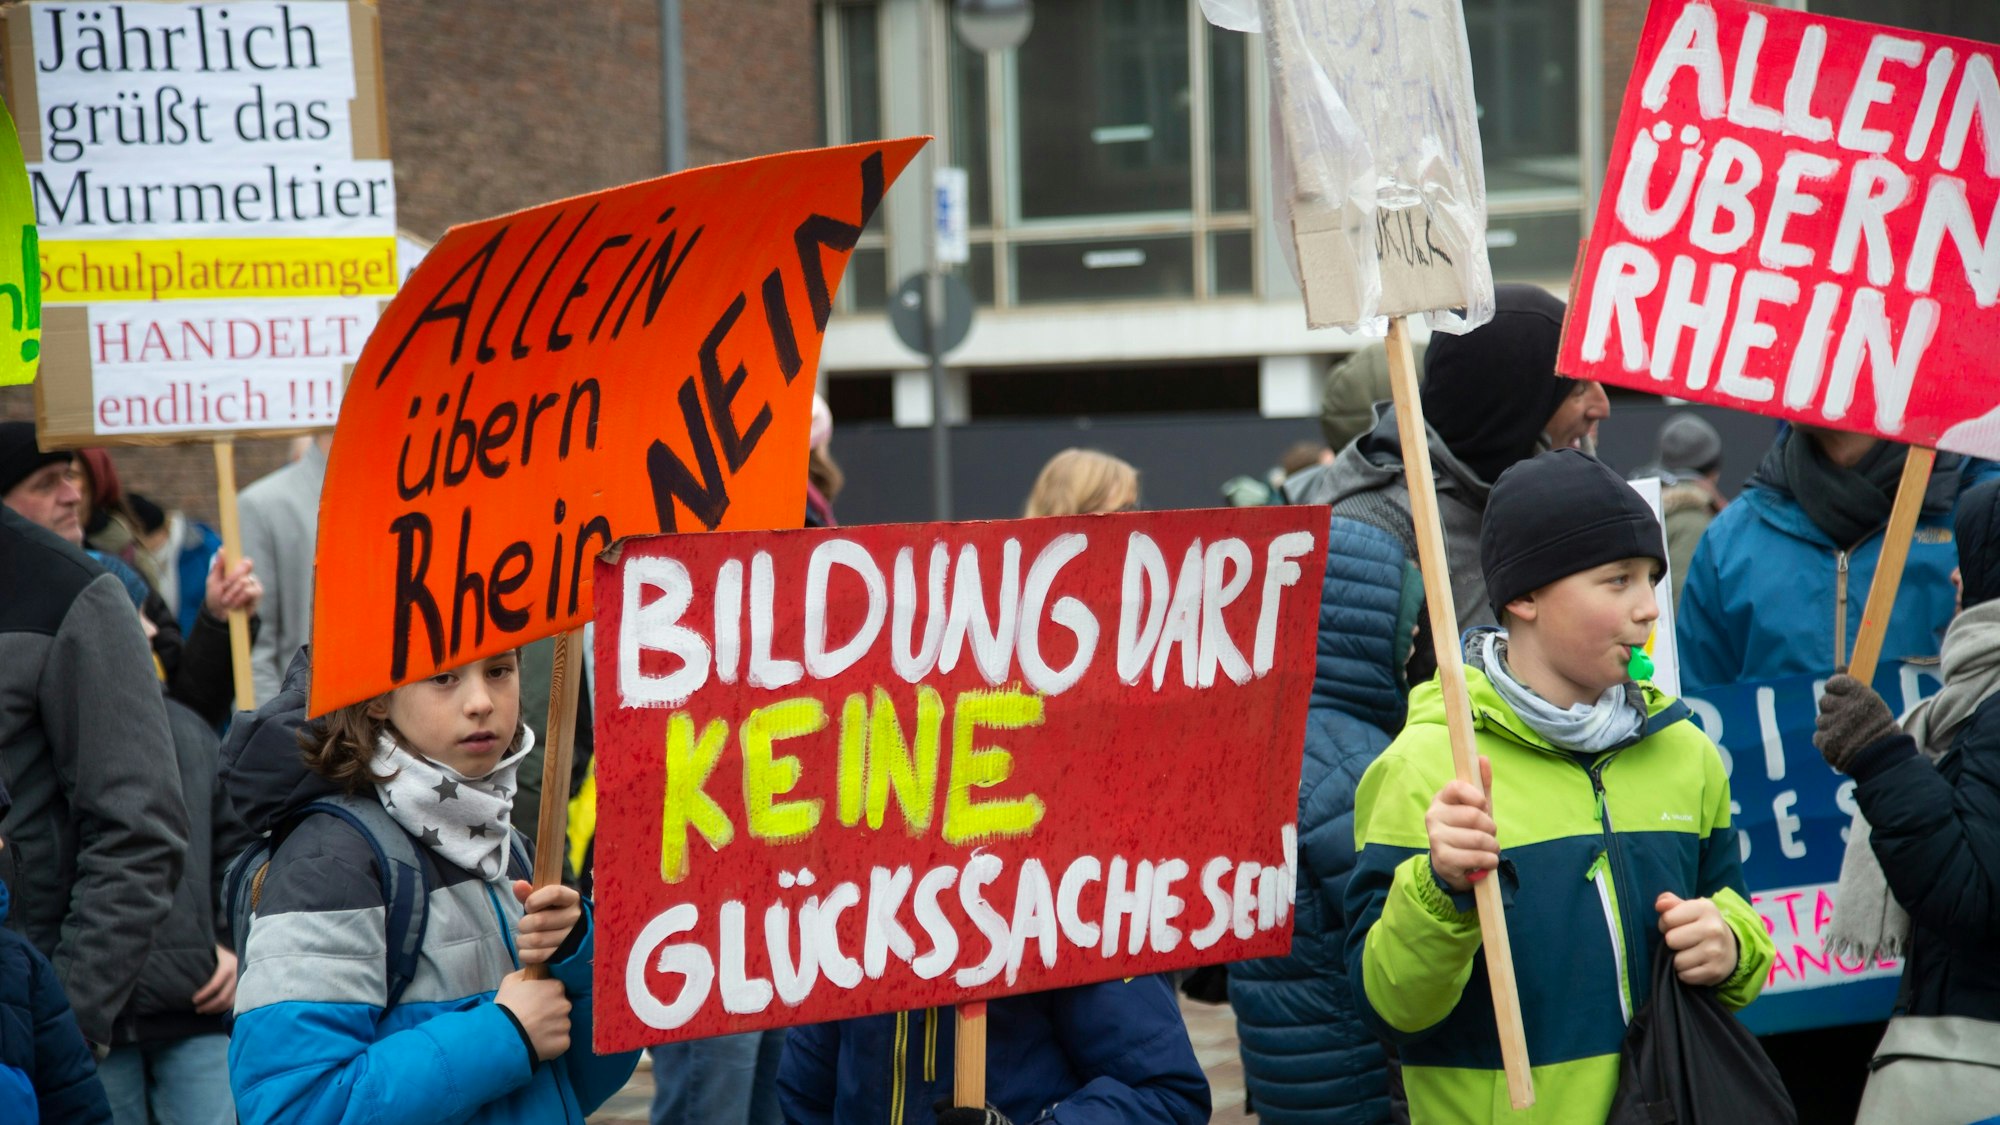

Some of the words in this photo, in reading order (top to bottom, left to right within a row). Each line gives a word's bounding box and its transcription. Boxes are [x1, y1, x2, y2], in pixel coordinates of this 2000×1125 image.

[39, 4, 321, 74] Jährlich
[47, 86, 213, 162] grüßt
[234, 84, 331, 142] das
[1641, 1, 2000, 178] ALLEIN
[34, 164, 387, 226] Murmeltier
[1616, 121, 2000, 307] ÜBERN
[95, 316, 359, 364] HANDELT
[98, 380, 268, 428] endlich
[646, 151, 884, 533] NEIN
[1581, 242, 1941, 435] RHEIN
[398, 371, 601, 501] übern
[389, 497, 612, 684] Rhein
[619, 533, 1100, 709] BILDUNG
[1117, 530, 1315, 692] DARF
[660, 680, 1046, 885] KEINE
